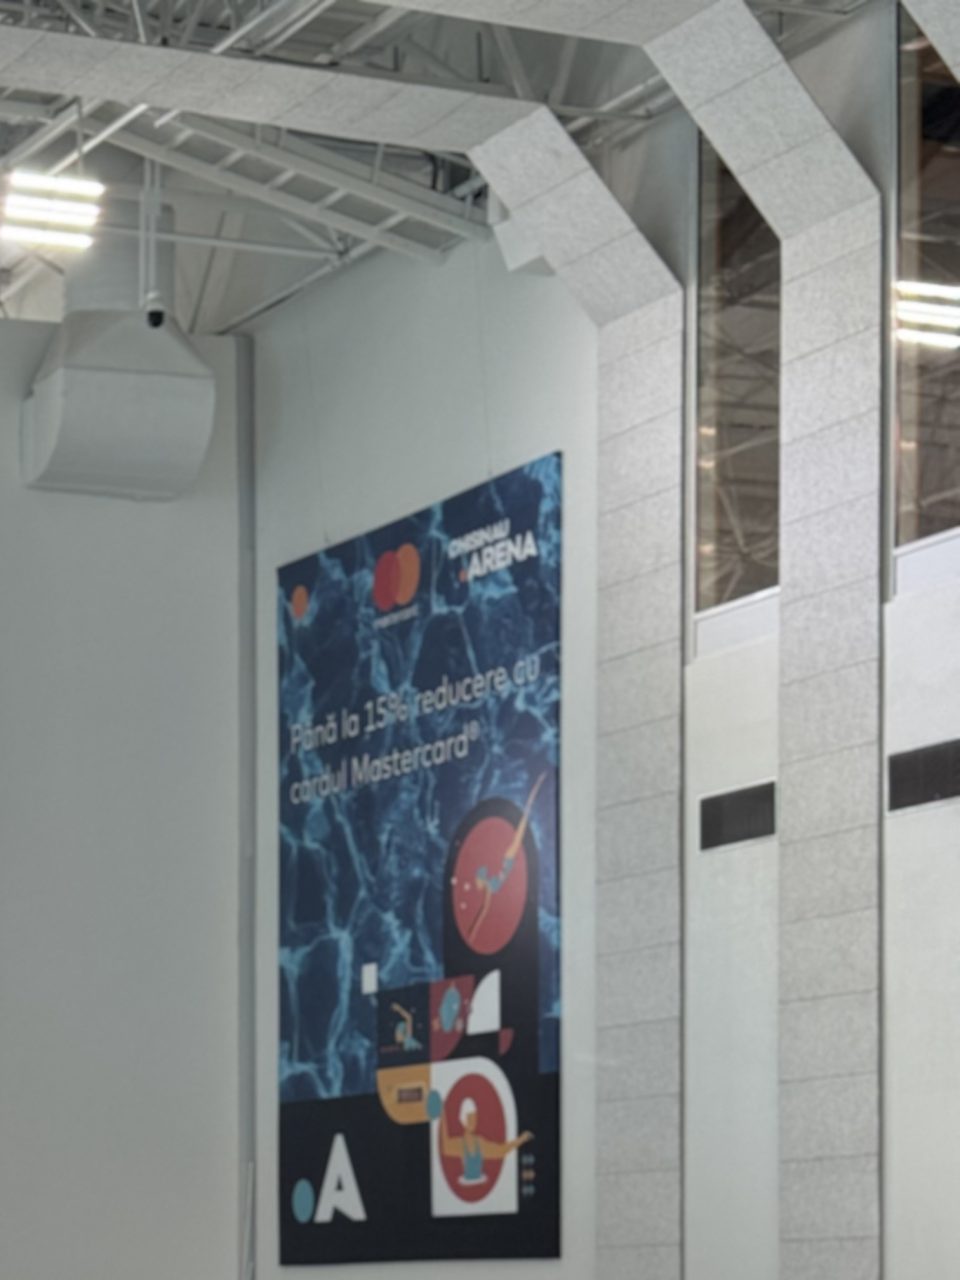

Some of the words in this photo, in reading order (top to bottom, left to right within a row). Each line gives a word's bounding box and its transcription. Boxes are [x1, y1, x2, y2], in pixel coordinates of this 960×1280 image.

[467, 529, 538, 581] ARENA
[341, 708, 359, 739] la
[364, 690, 409, 734] 15%
[415, 666, 507, 714] reducere
[513, 655, 540, 686] cu
[290, 758, 347, 805] cardul
